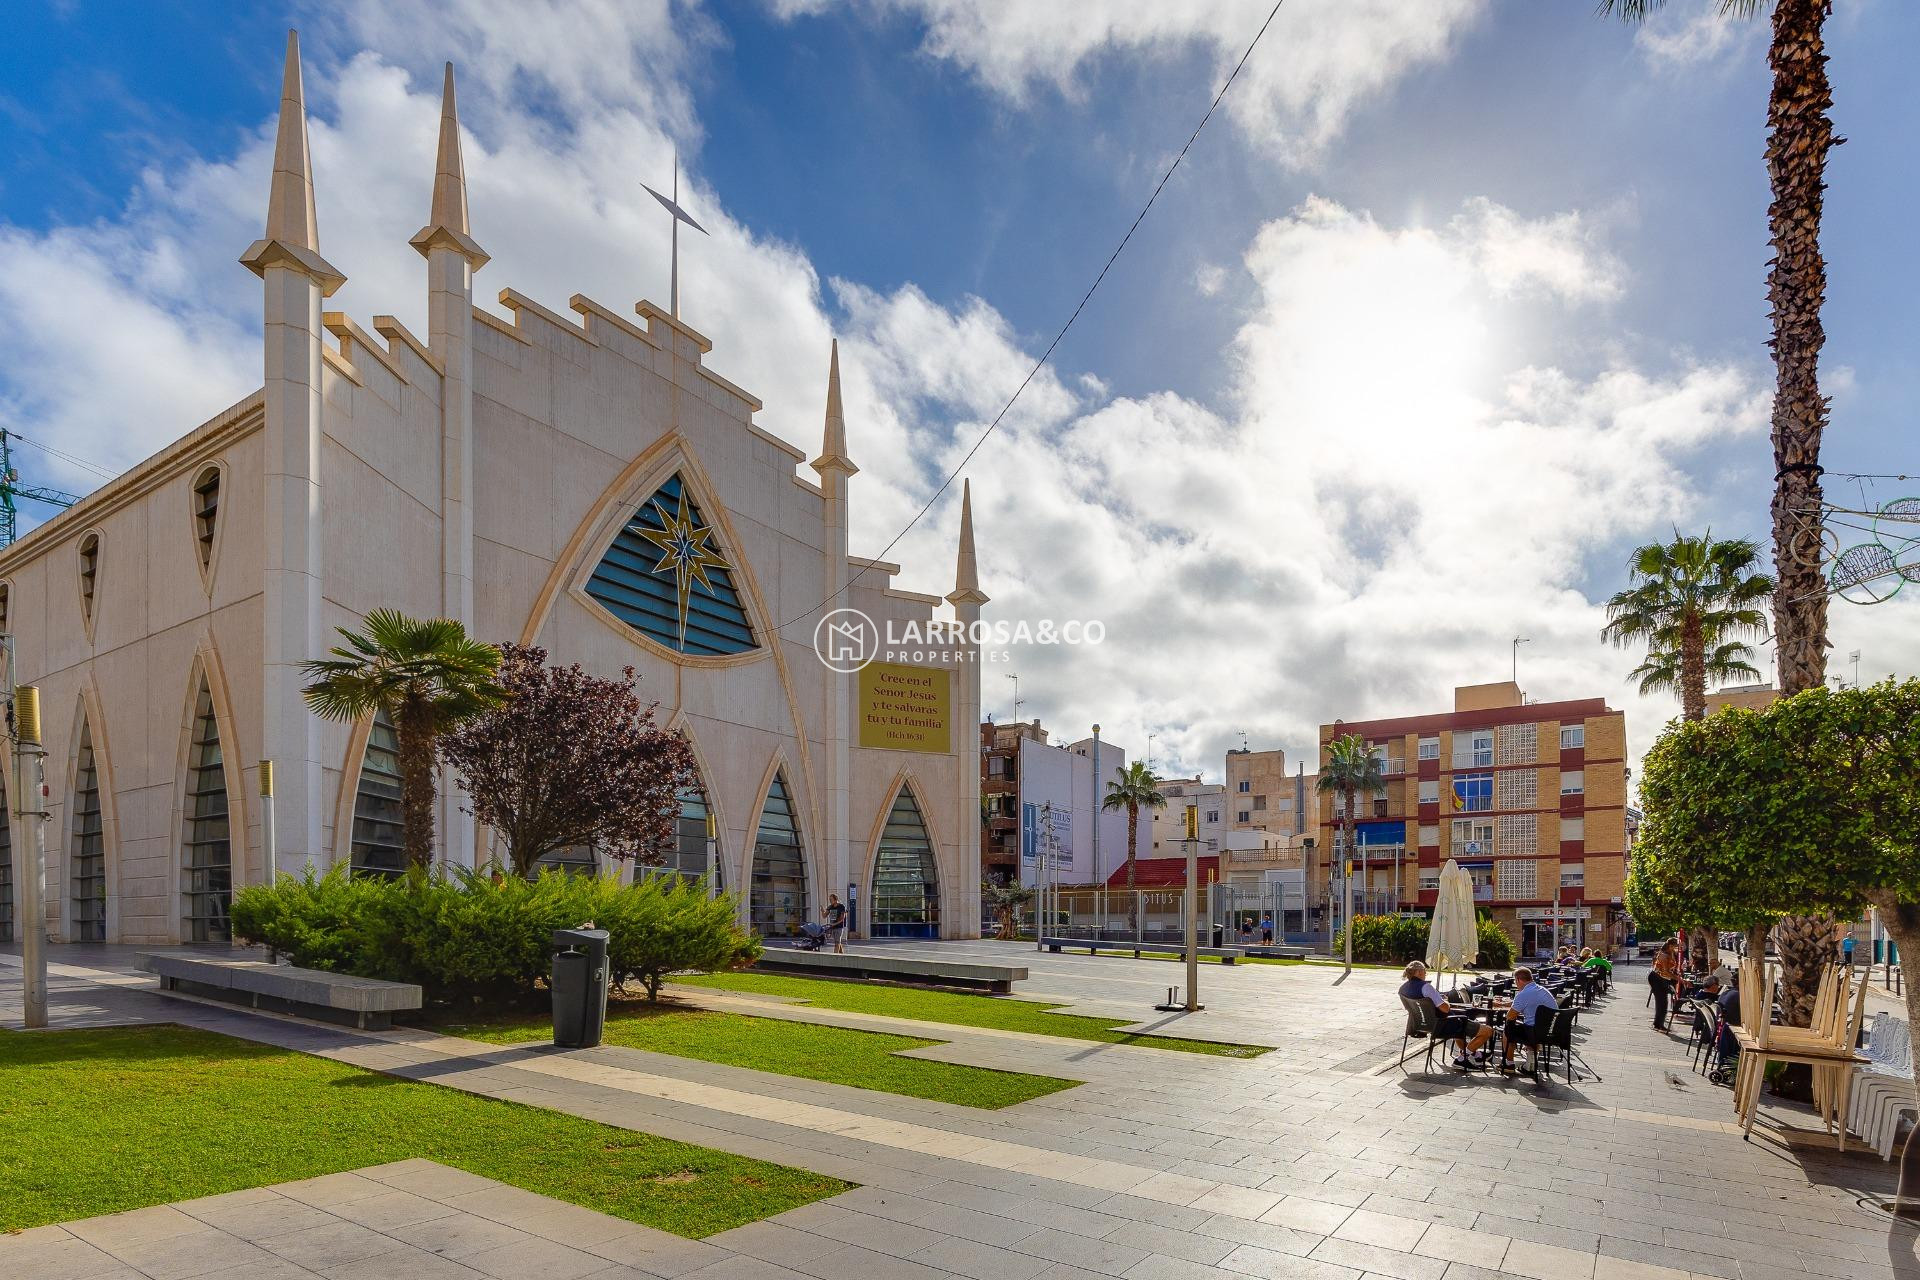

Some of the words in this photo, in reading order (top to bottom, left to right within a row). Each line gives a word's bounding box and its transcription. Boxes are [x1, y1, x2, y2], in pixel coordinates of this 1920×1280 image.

[907, 677, 920, 686] en
[922, 677, 932, 687] el
[872, 701, 879, 711] y
[881, 702, 892, 710] te
[879, 716, 888, 725] y
[890, 715, 901, 725] tu
